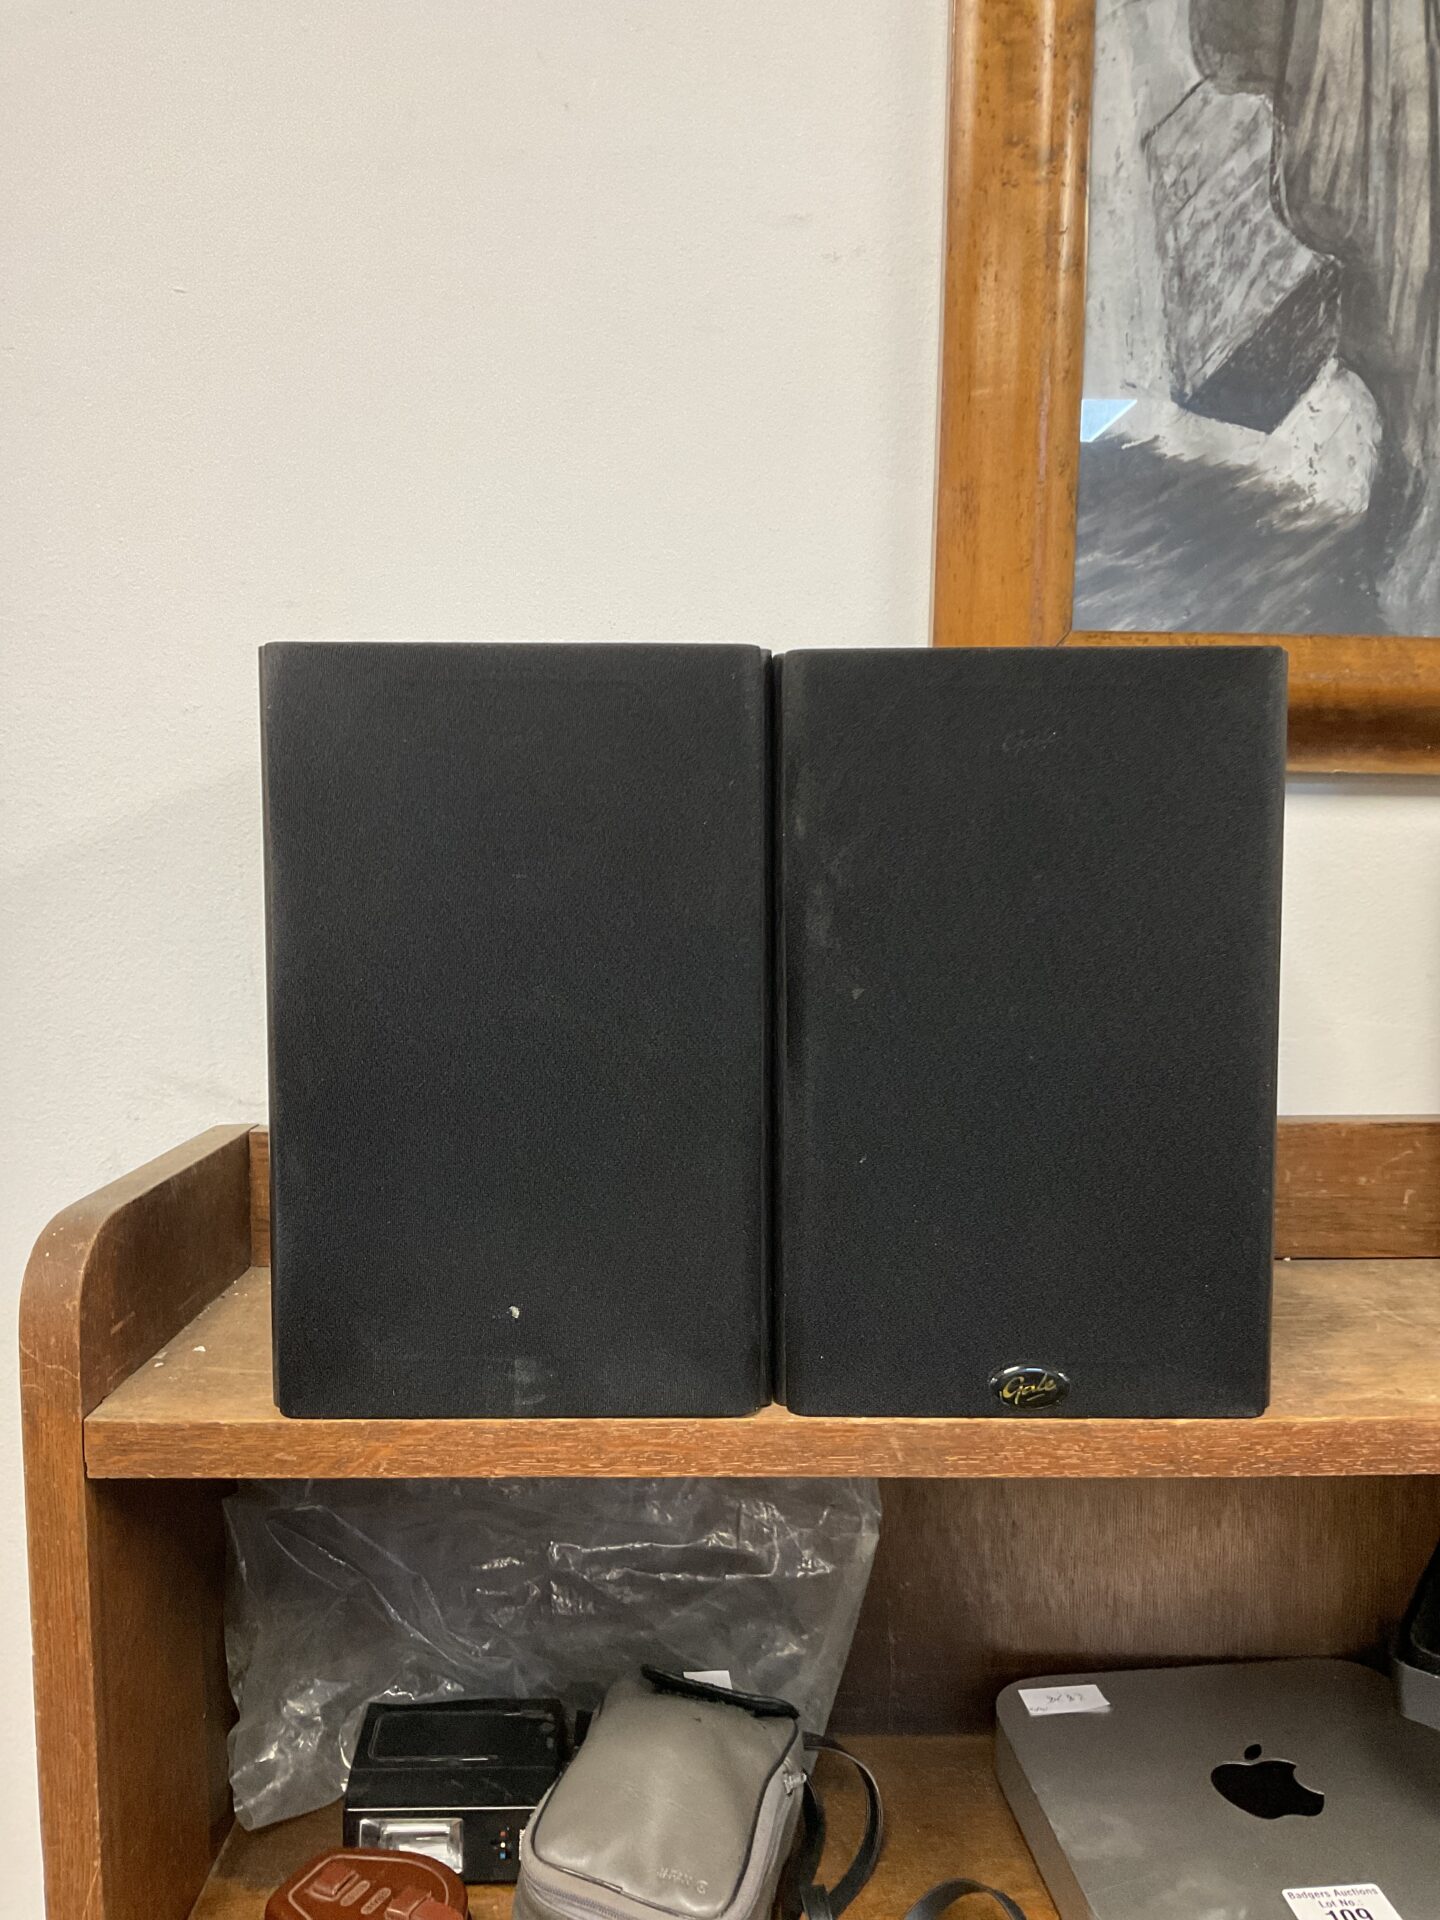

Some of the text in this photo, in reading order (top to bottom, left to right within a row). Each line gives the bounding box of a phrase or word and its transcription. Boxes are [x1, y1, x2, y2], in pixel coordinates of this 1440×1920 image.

[1287, 1888, 1378, 1900] Badgers Auctions
[1318, 1900, 1337, 1908] Lot
